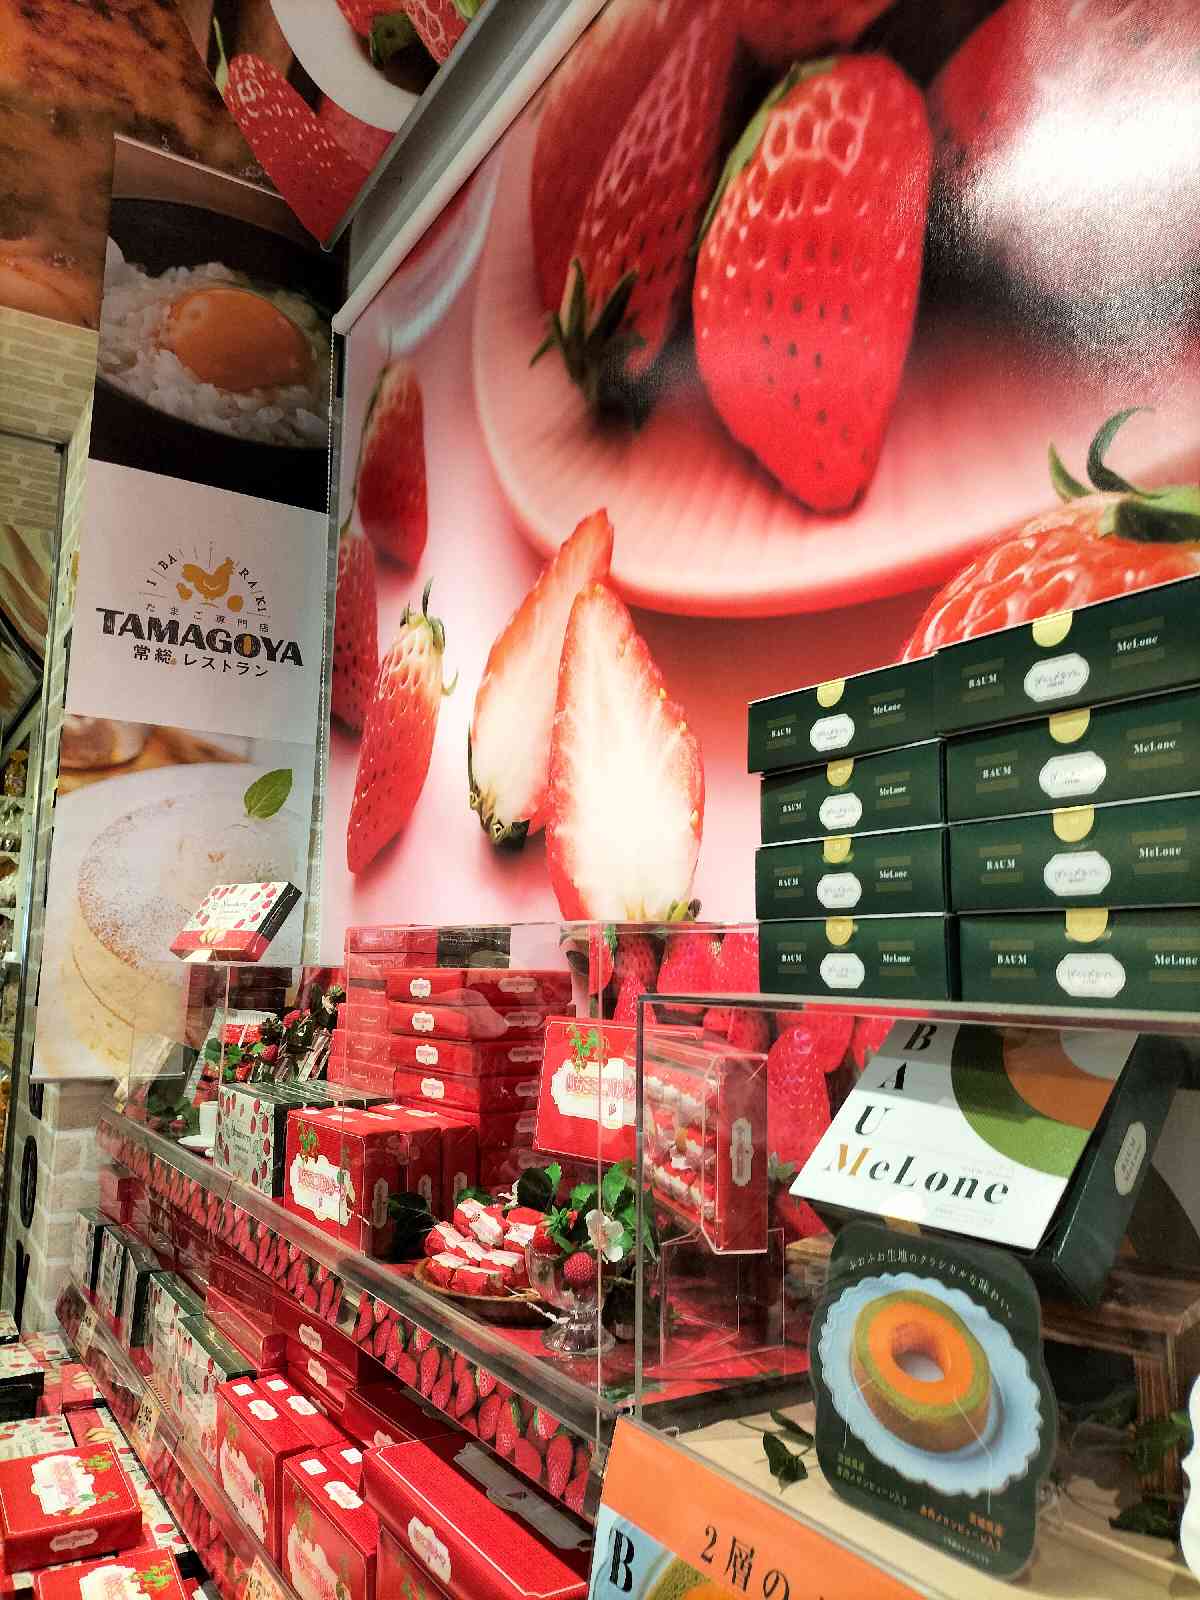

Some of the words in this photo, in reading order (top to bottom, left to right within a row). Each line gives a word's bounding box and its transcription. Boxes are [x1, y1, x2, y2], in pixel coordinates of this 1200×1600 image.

[95, 607, 305, 667] TAMAGOYA
[1117, 633, 1159, 652] MeLone
[133, 644, 173, 665] 常総
[184, 653, 269, 678] レストラン
[1133, 739, 1177, 754] MeLone
[1138, 845, 1182, 858] MeLone
[997, 954, 1027, 966] BAUM
[1154, 953, 1200, 966] MeLone
